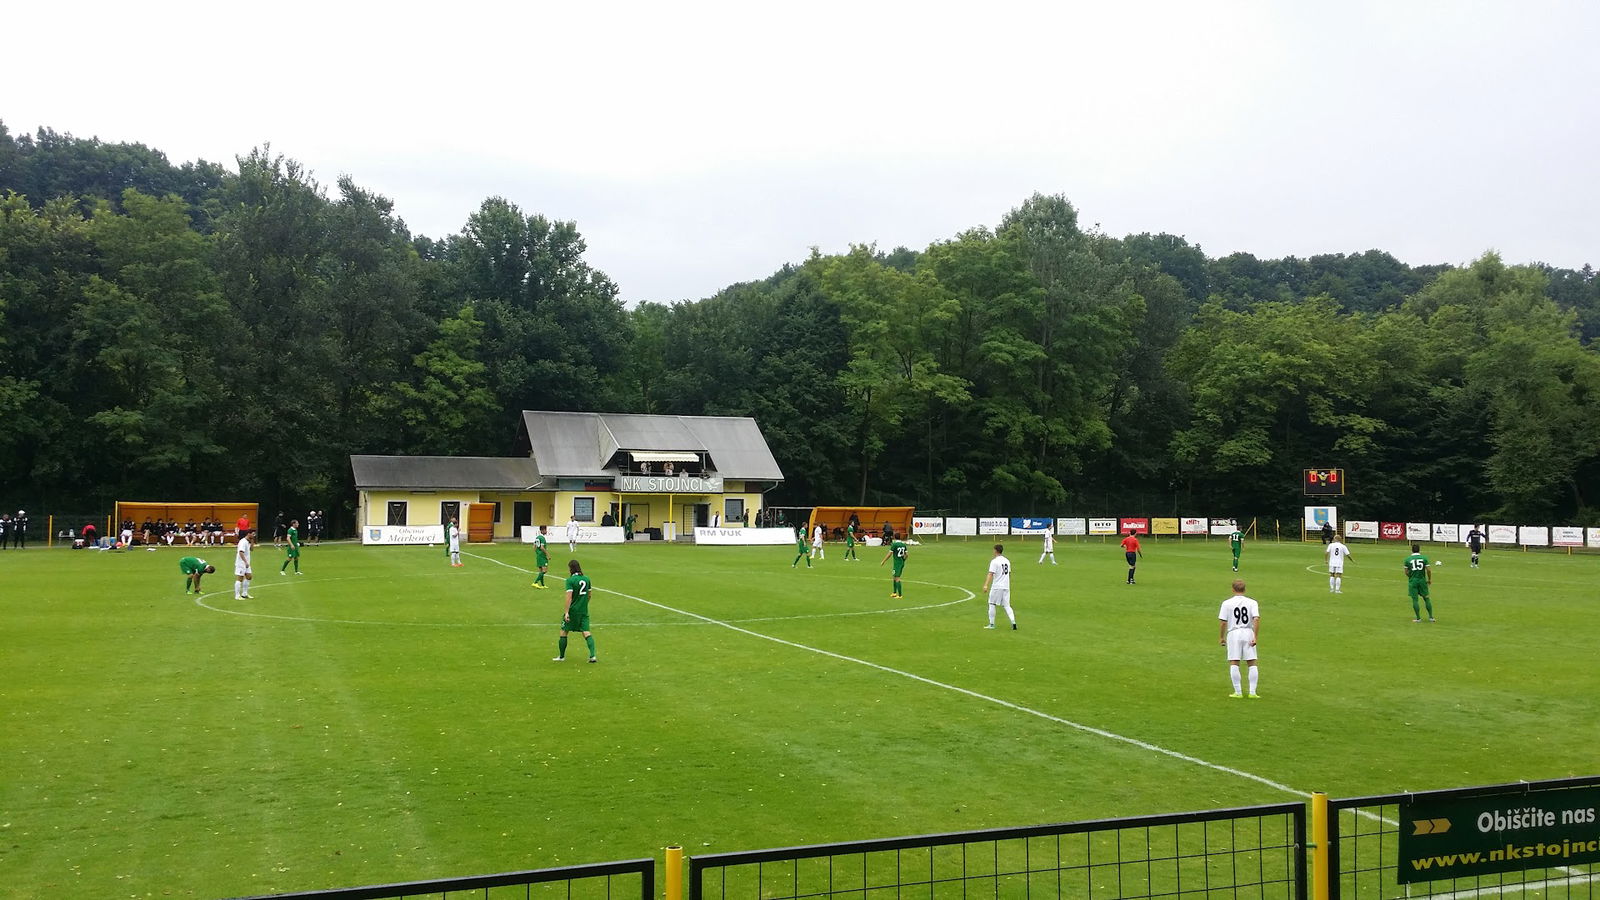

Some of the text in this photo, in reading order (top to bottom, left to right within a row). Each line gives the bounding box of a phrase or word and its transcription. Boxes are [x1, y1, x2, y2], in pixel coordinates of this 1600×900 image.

[623, 478, 703, 491] NK STOJNCI
[387, 534, 436, 542] Markovci
[1232, 533, 1240, 541] 11
[1334, 547, 1340, 556] 8
[1409, 559, 1424, 571] 15
[579, 580, 587, 595] 2
[1233, 606, 1249, 625] 98
[1477, 806, 1596, 833] Obiščite nas
[1411, 838, 1600, 871] www.nkstojnc
